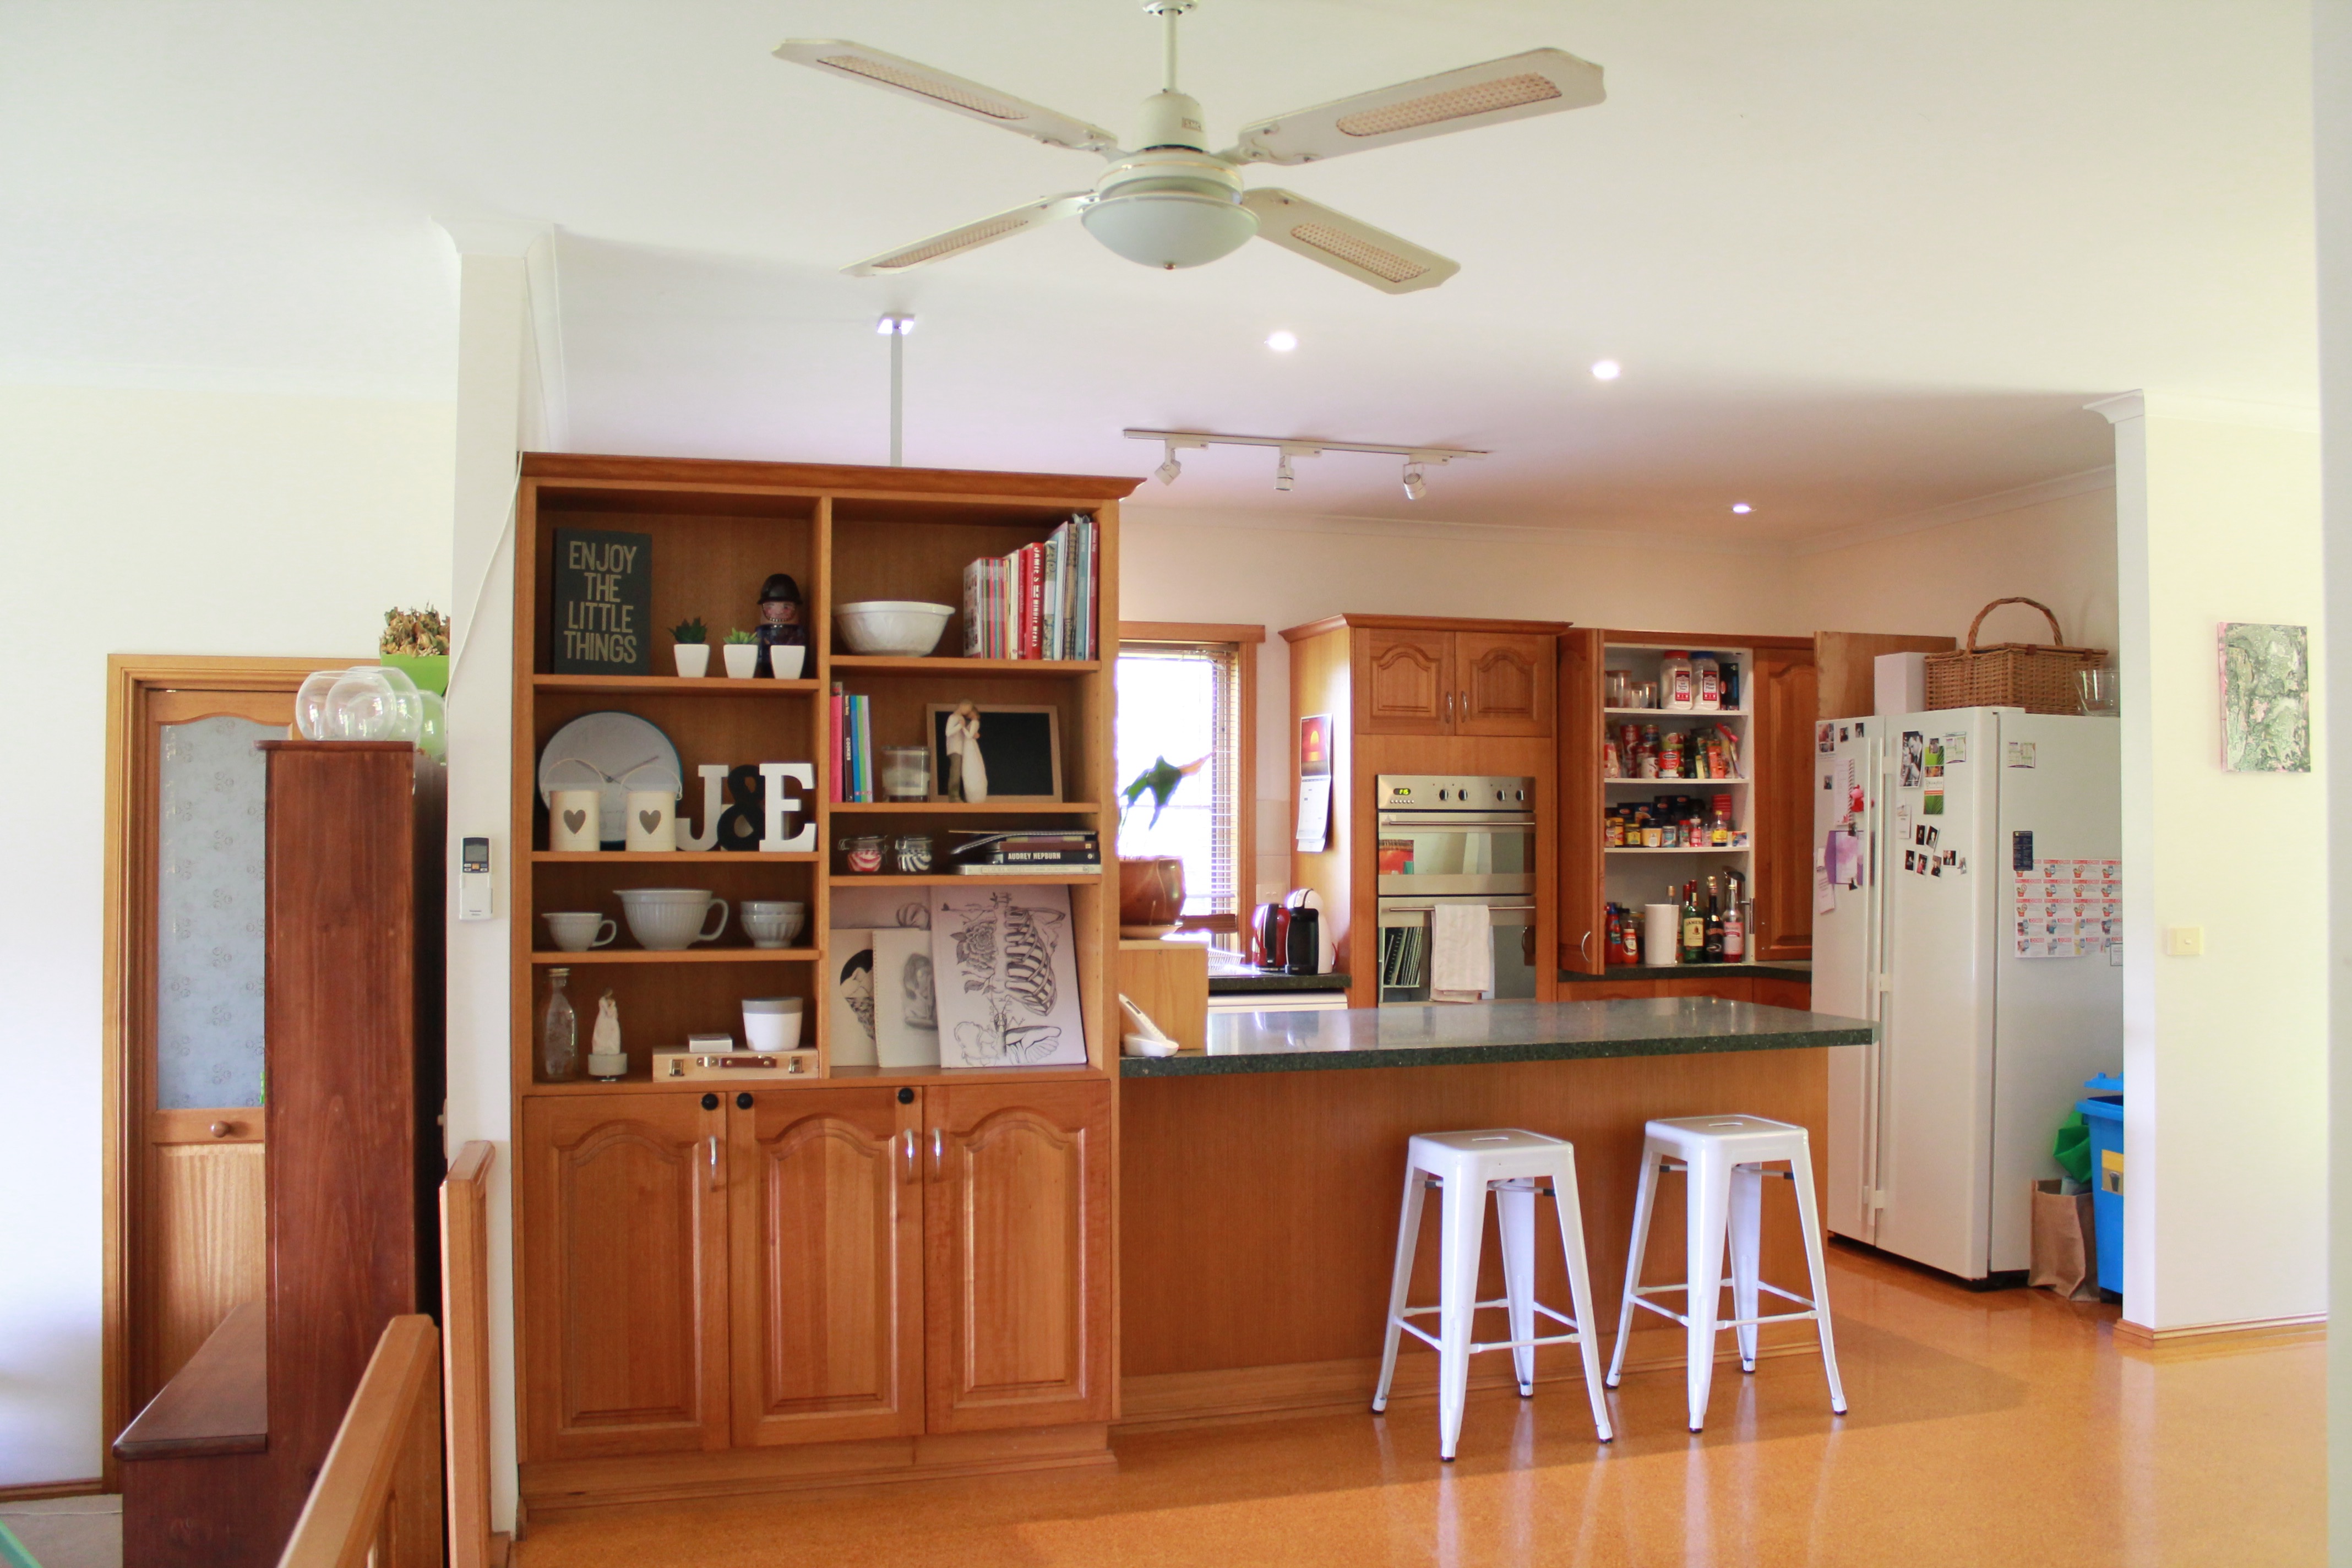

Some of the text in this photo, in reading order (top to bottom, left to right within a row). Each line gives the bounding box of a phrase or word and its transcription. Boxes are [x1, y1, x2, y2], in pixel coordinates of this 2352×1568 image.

[569, 541, 637, 574] ENJOY
[584, 572, 622, 603] THE
[568, 601, 634, 633] LITTLE
[563, 630, 637, 663] THINGS
